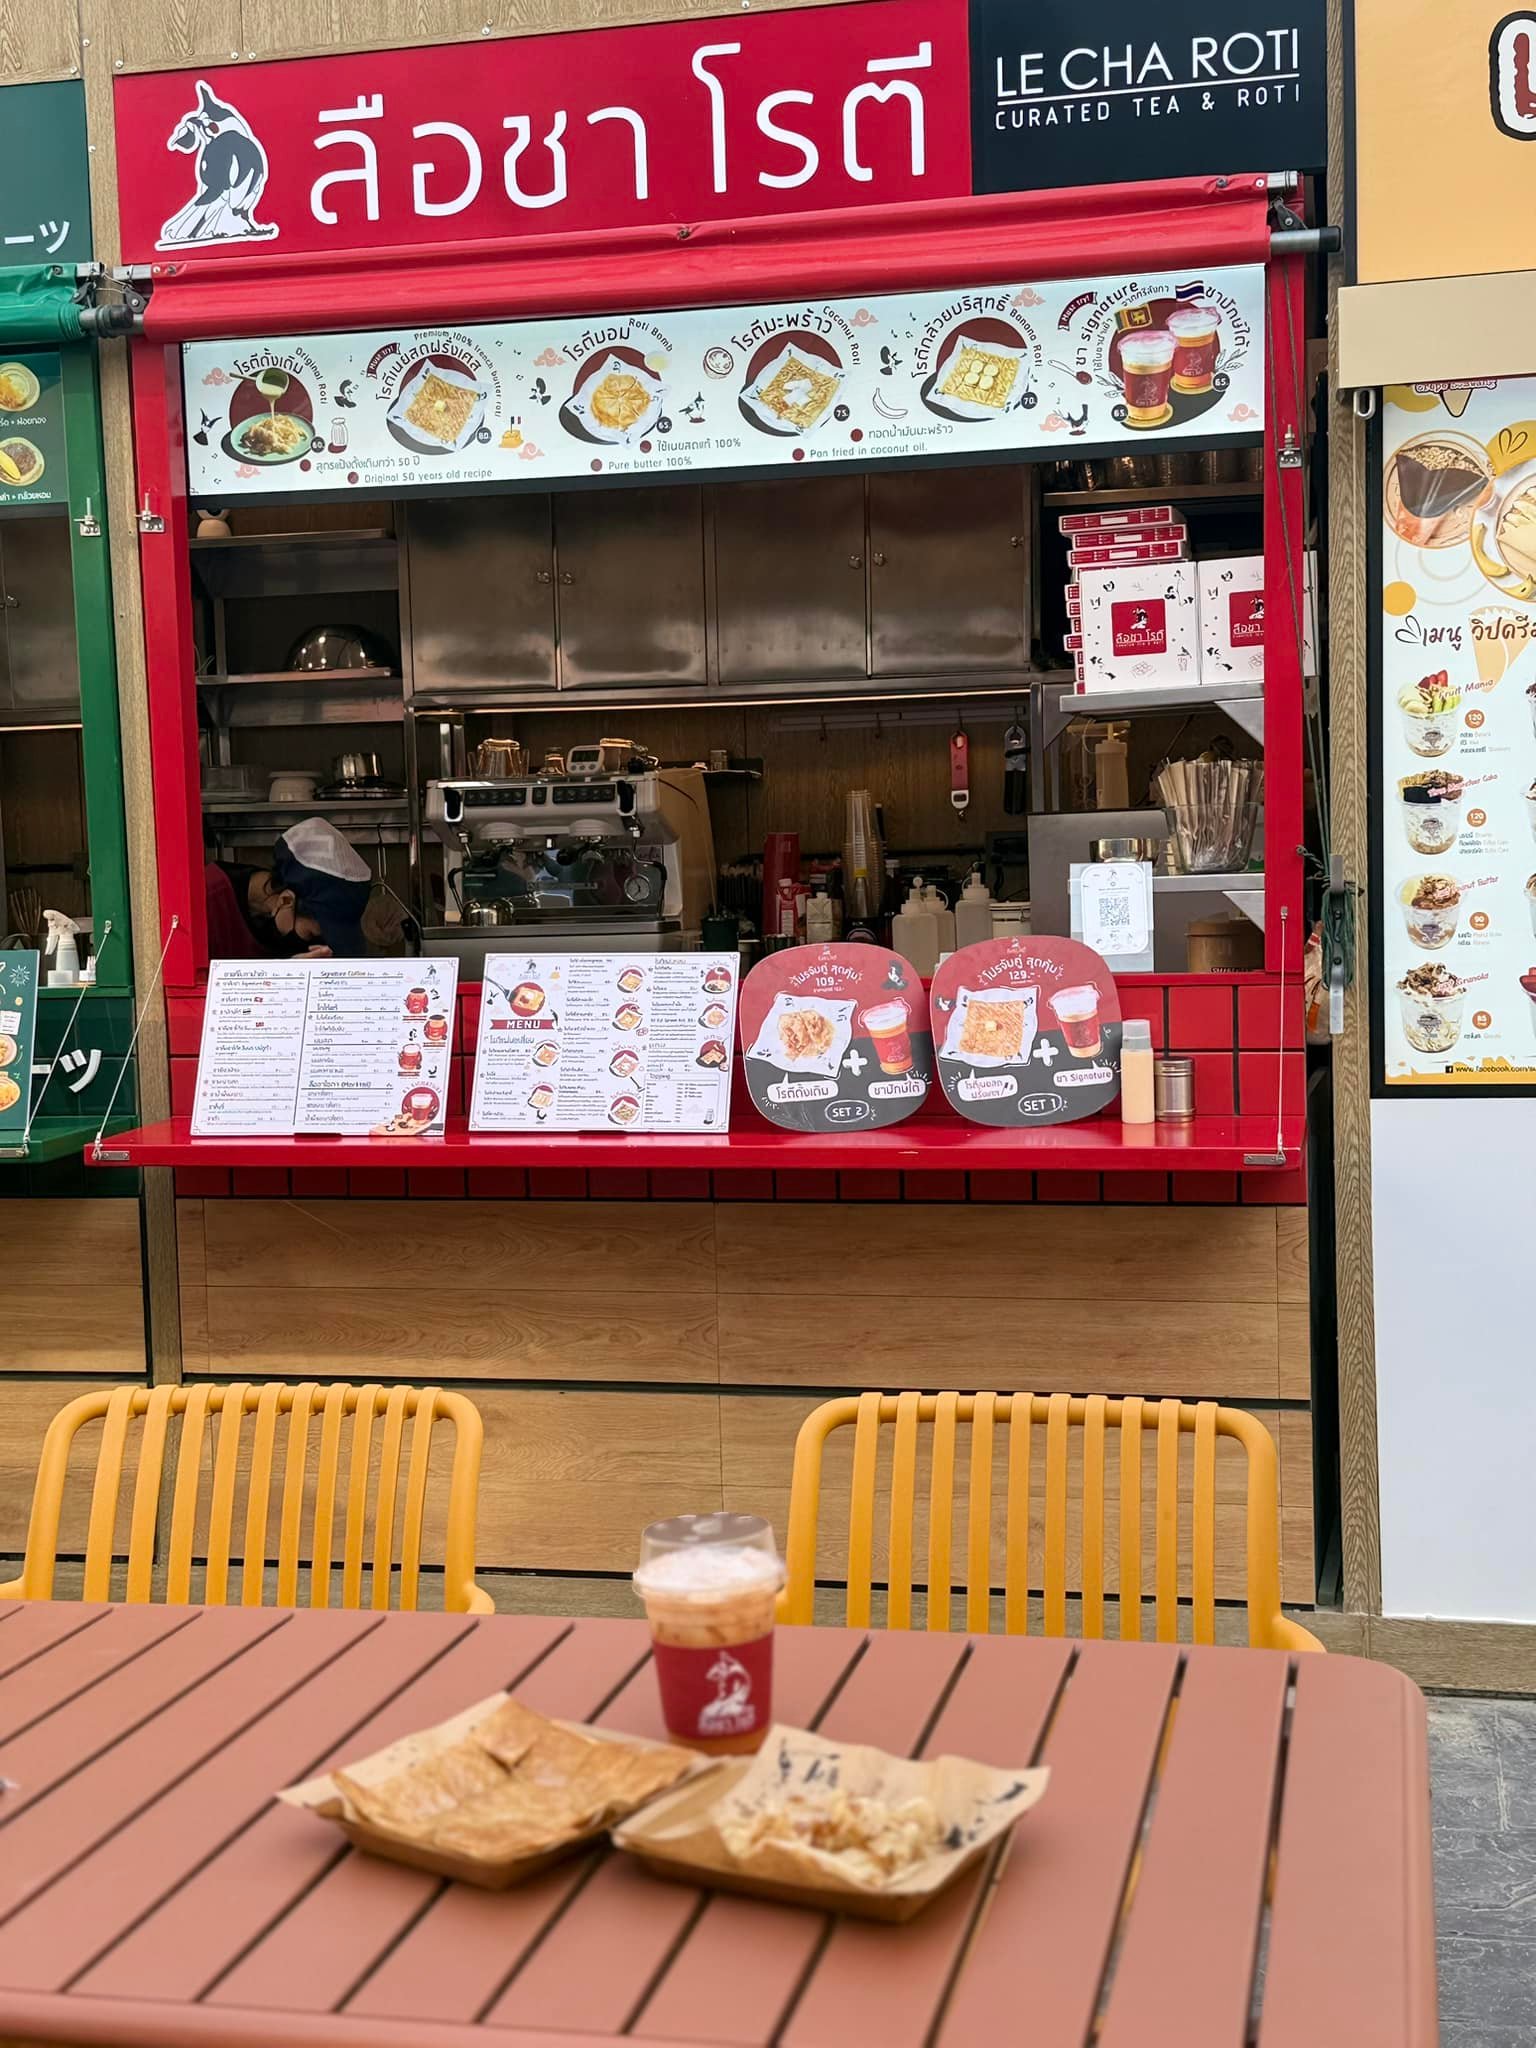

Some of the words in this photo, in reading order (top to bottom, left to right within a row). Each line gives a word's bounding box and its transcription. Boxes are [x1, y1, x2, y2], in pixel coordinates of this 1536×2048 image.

[995, 52, 1045, 98] LE
[1060, 41, 1173, 92] CHA
[1192, 28, 1300, 79] ROTI
[994, 102, 1111, 131] CURATED
[1132, 95, 1180, 119] TEA
[1201, 91, 1215, 111] &
[1237, 83, 1301, 108] ROTI
[310, 93, 649, 225] ลือชา
[691, 41, 932, 194] โรตี
[822, 305, 855, 340] Coconut
[1083, 280, 1139, 342] signature
[628, 317, 650, 332] Roti
[650, 326, 673, 353] Bomb
[731, 308, 833, 352] โรตีมะพร้าว
[1009, 307, 1037, 341] Banana
[1032, 343, 1043, 368] Roti
[562, 326, 631, 363] โรตีบอม
[234, 347, 305, 376] โรตีดั้งเดิม
[295, 346, 324, 381] Original
[714, 437, 741, 449] 100%
[810, 448, 829, 458] Pan
[832, 447, 855, 457] fried
[858, 447, 868, 456] in
[870, 444, 909, 455] coconut
[398, 459, 410, 468] 50
[608, 460, 630, 470] Pure
[634, 458, 662, 469] butter
[666, 456, 693, 467] 100%
[364, 474, 399, 485] Original
[402, 471, 415, 482] 50
[418, 469, 443, 482] years
[445, 468, 461, 480] old
[463, 469, 493, 481] recipe
[1423, 622, 1463, 652] เมนู
[815, 977, 843, 988] 109.-
[1009, 970, 1036, 981] 129.-
[507, 1020, 541, 1029] MENU
[1070, 1070, 1112, 1083] Signature
[775, 1083, 830, 1100] โรตีดั้งเดิม
[831, 1107, 852, 1118] SET
[855, 1106, 864, 1117] 2
[1023, 1100, 1046, 1112] SET
[1050, 1099, 1057, 1110] 1
